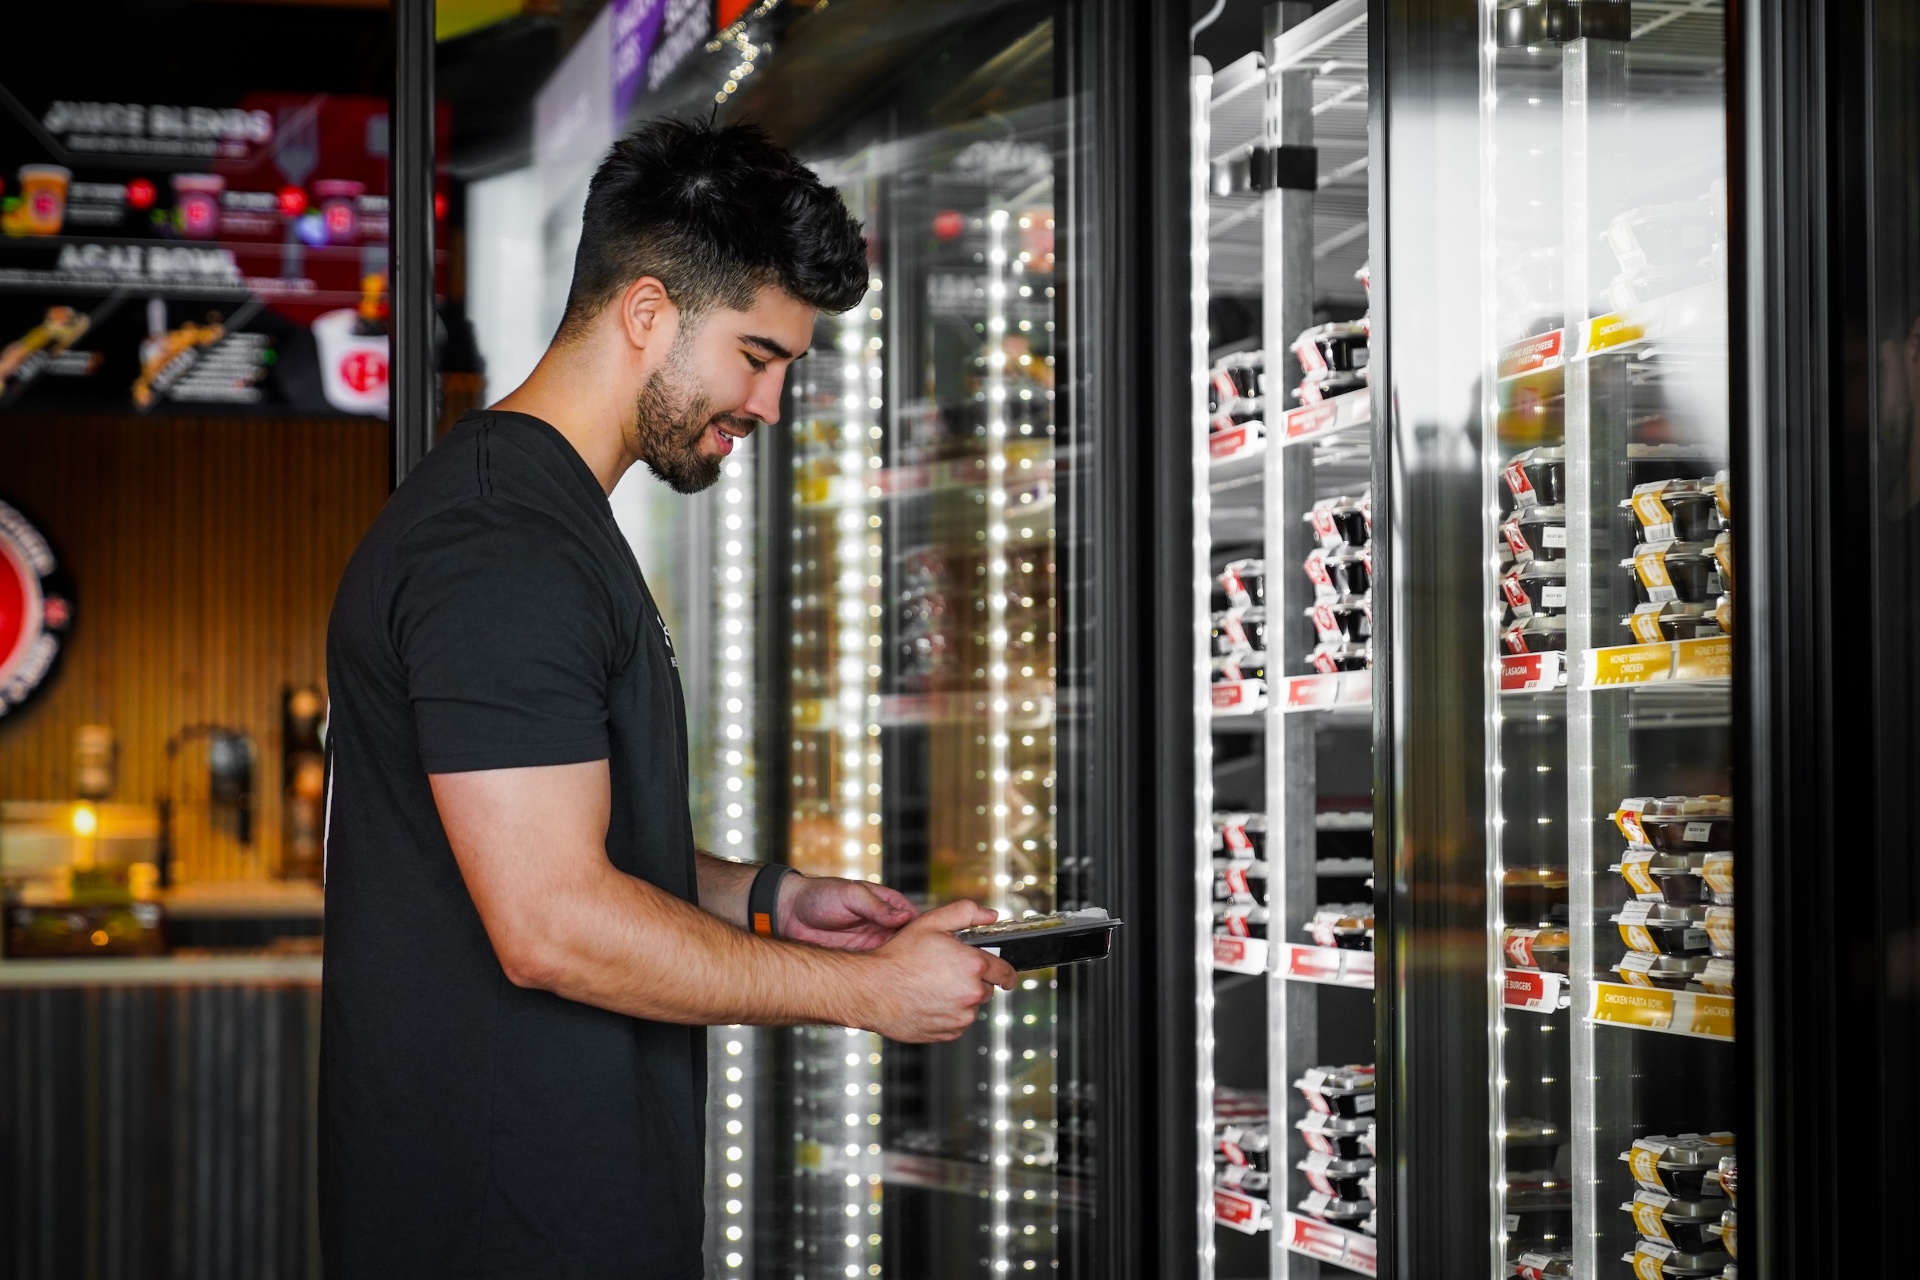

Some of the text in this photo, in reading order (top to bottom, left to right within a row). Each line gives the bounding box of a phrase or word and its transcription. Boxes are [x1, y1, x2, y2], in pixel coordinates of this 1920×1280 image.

[1522, 344, 1536, 356] BEEF
[1535, 338, 1555, 352] CHEESE
[1610, 654, 1628, 664] HONEY
[1505, 665, 1528, 676] LASAGNA
[1621, 662, 1644, 673] CHICKEN
[1509, 980, 1532, 991] BURGERS
[1604, 993, 1665, 1010] CHICKEN FAJITA BOWL
